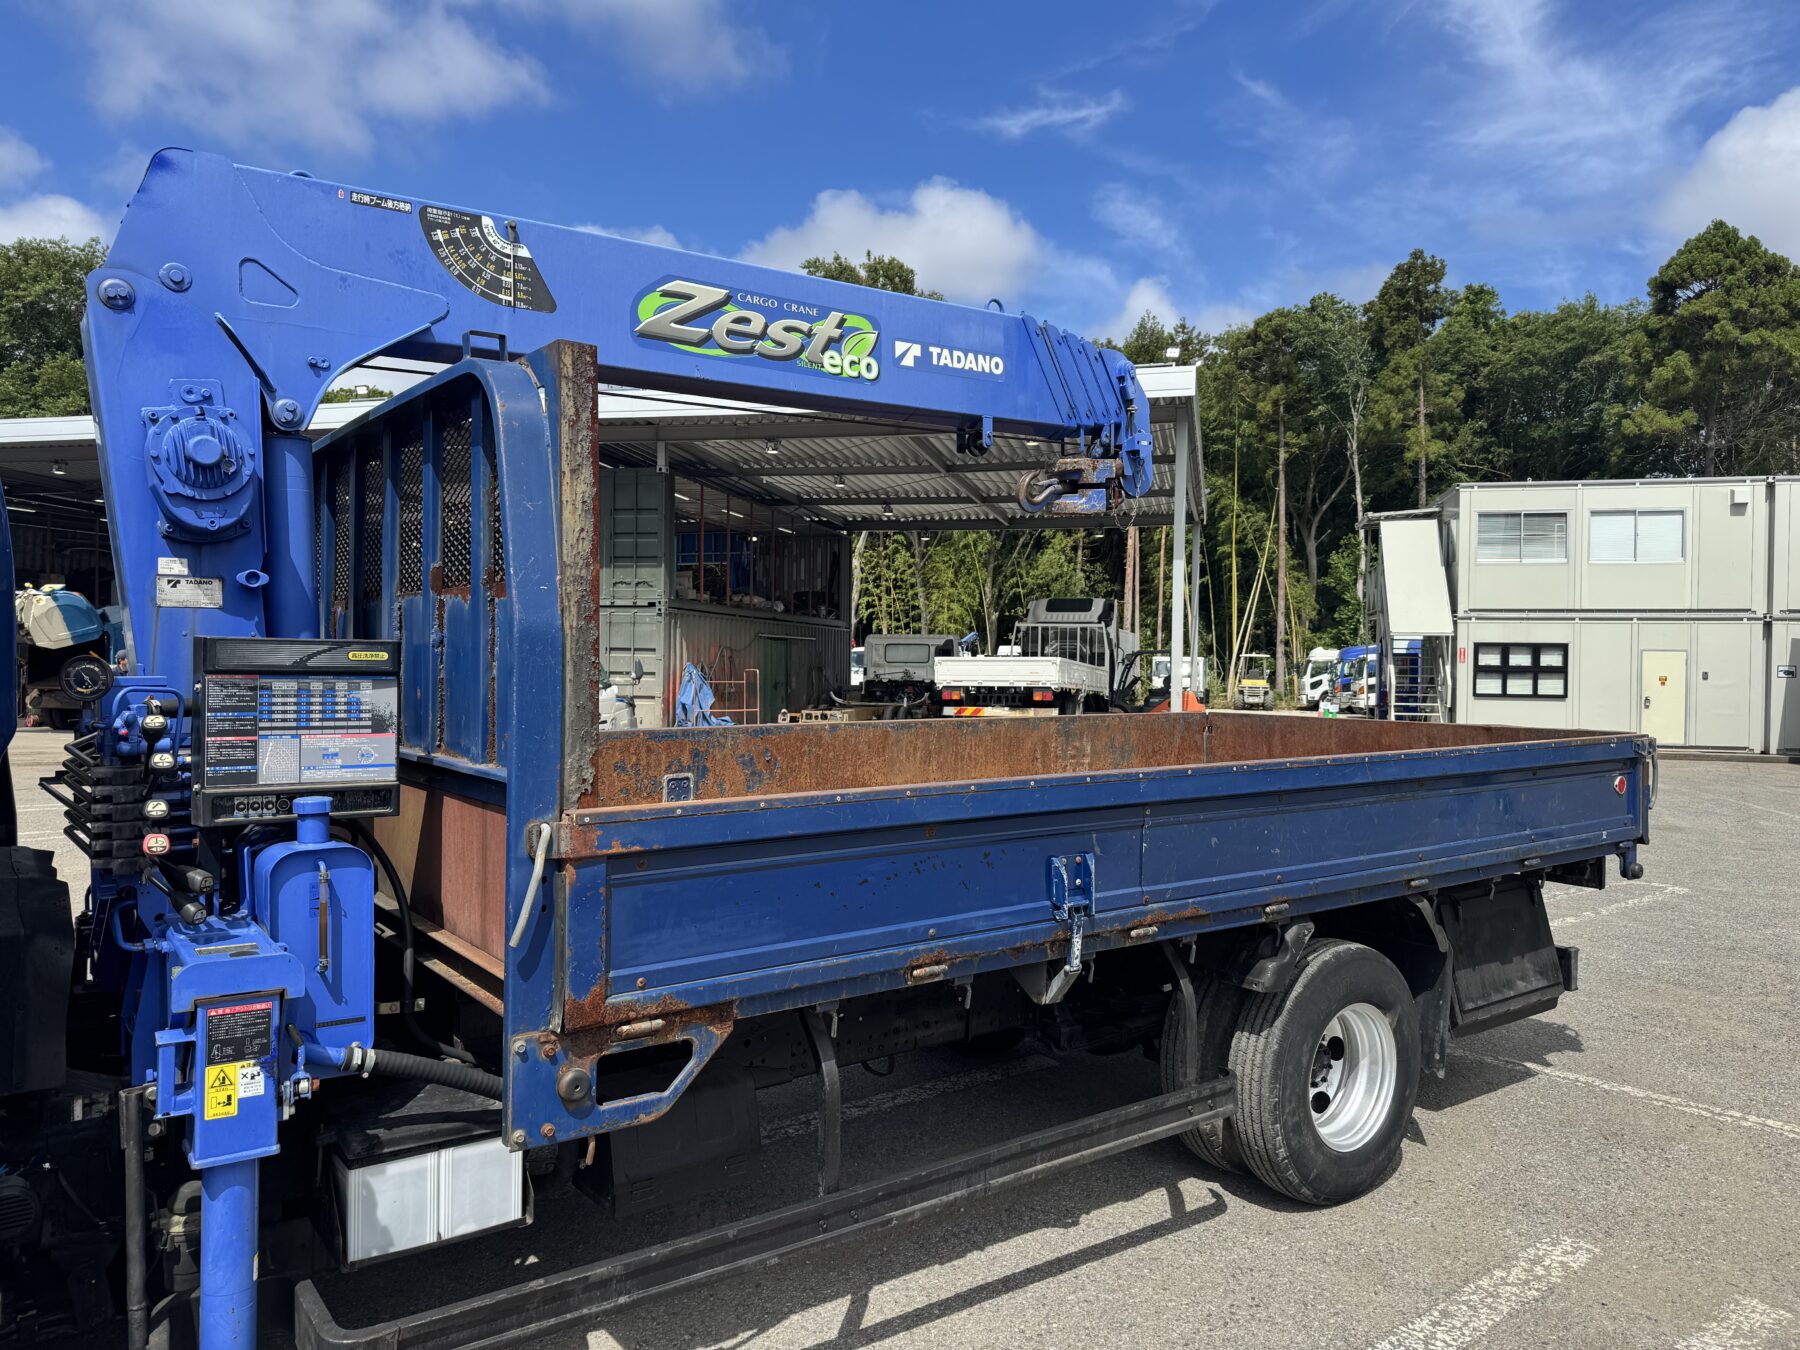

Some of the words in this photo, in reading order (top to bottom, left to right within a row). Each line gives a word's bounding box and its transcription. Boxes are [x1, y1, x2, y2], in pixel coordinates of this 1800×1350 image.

[737, 292, 778, 309] CARGO
[783, 302, 820, 317] CRANE
[634, 279, 846, 362] Zest
[796, 360, 823, 371] SILENT
[823, 349, 879, 381] eco
[928, 346, 1004, 375] TADANO
